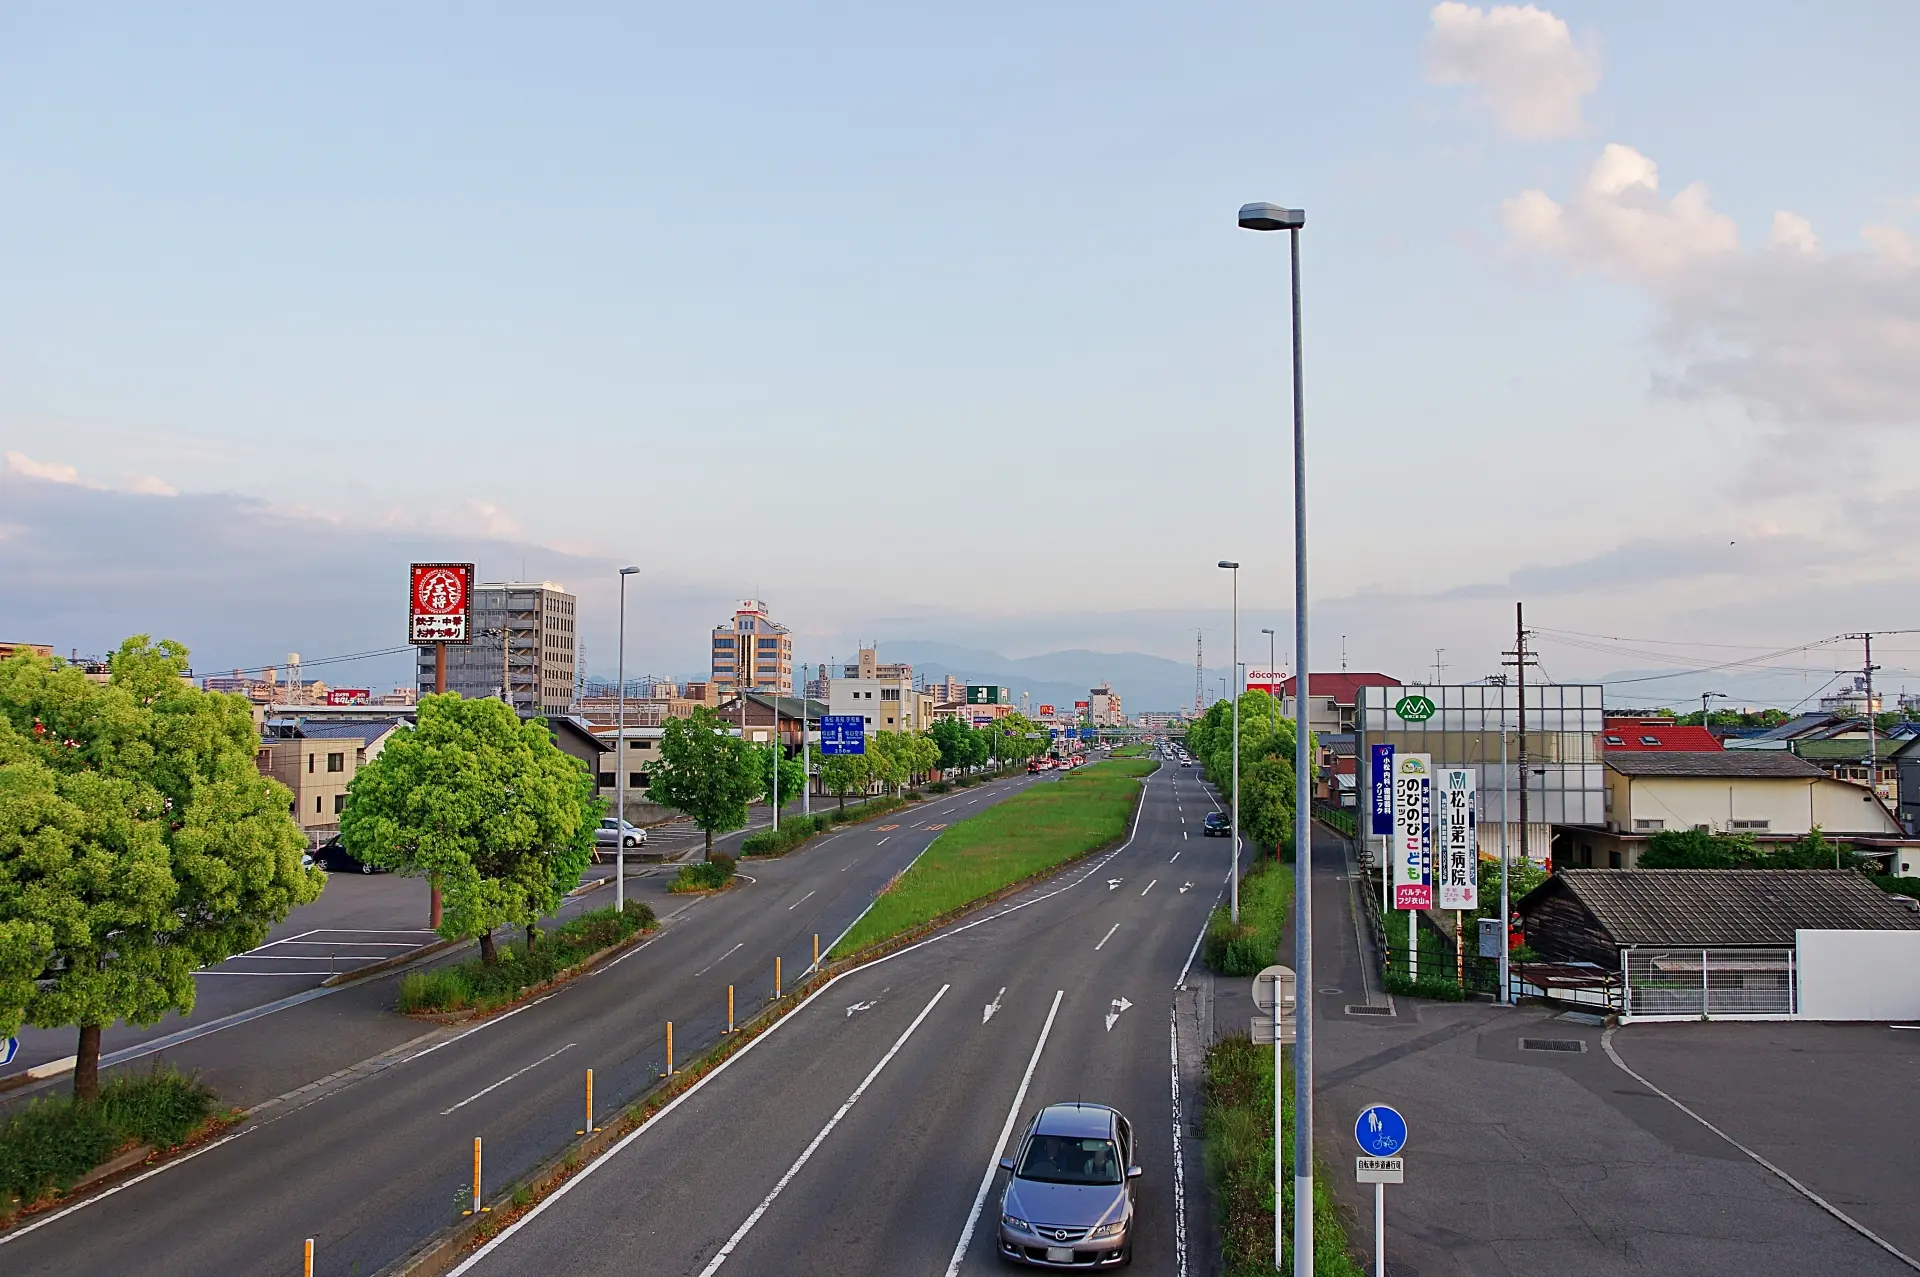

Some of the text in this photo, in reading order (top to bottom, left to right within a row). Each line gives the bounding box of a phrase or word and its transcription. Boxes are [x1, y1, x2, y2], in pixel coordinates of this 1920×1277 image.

[416, 627, 461, 639] お持ち帰り
[1249, 670, 1287, 679] docomo
[1376, 782, 1384, 815] クリニック
[1396, 779, 1406, 827] クリニック
[1406, 778, 1421, 881] のびのびこども
[1450, 790, 1467, 887] 松山第一病院
[1358, 1160, 1401, 1169] 自転車歩道通行可
